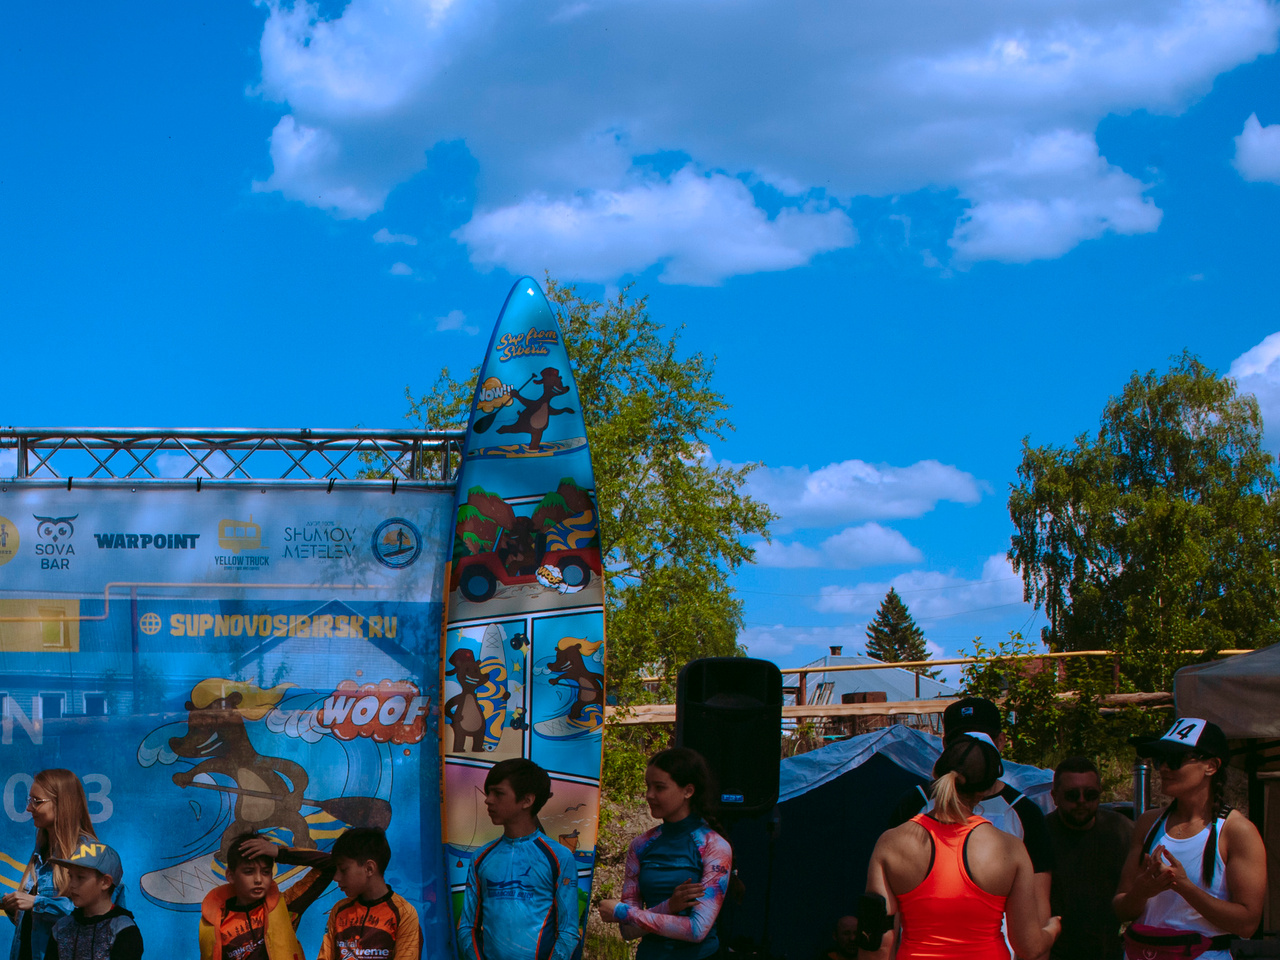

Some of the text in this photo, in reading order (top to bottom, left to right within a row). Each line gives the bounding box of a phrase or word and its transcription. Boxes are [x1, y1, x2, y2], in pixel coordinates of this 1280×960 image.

[283, 526, 357, 542] SHUMOV
[35, 543, 75, 557] SOVA
[283, 544, 356, 558] METELEV
[40, 557, 70, 570] BAR
[214, 555, 270, 566] YELLOW TRUCK
[170, 613, 397, 640] SUPNOVOSIBIRSK.RU
[322, 695, 431, 726] WOOF
[1168, 719, 1197, 740] 14
